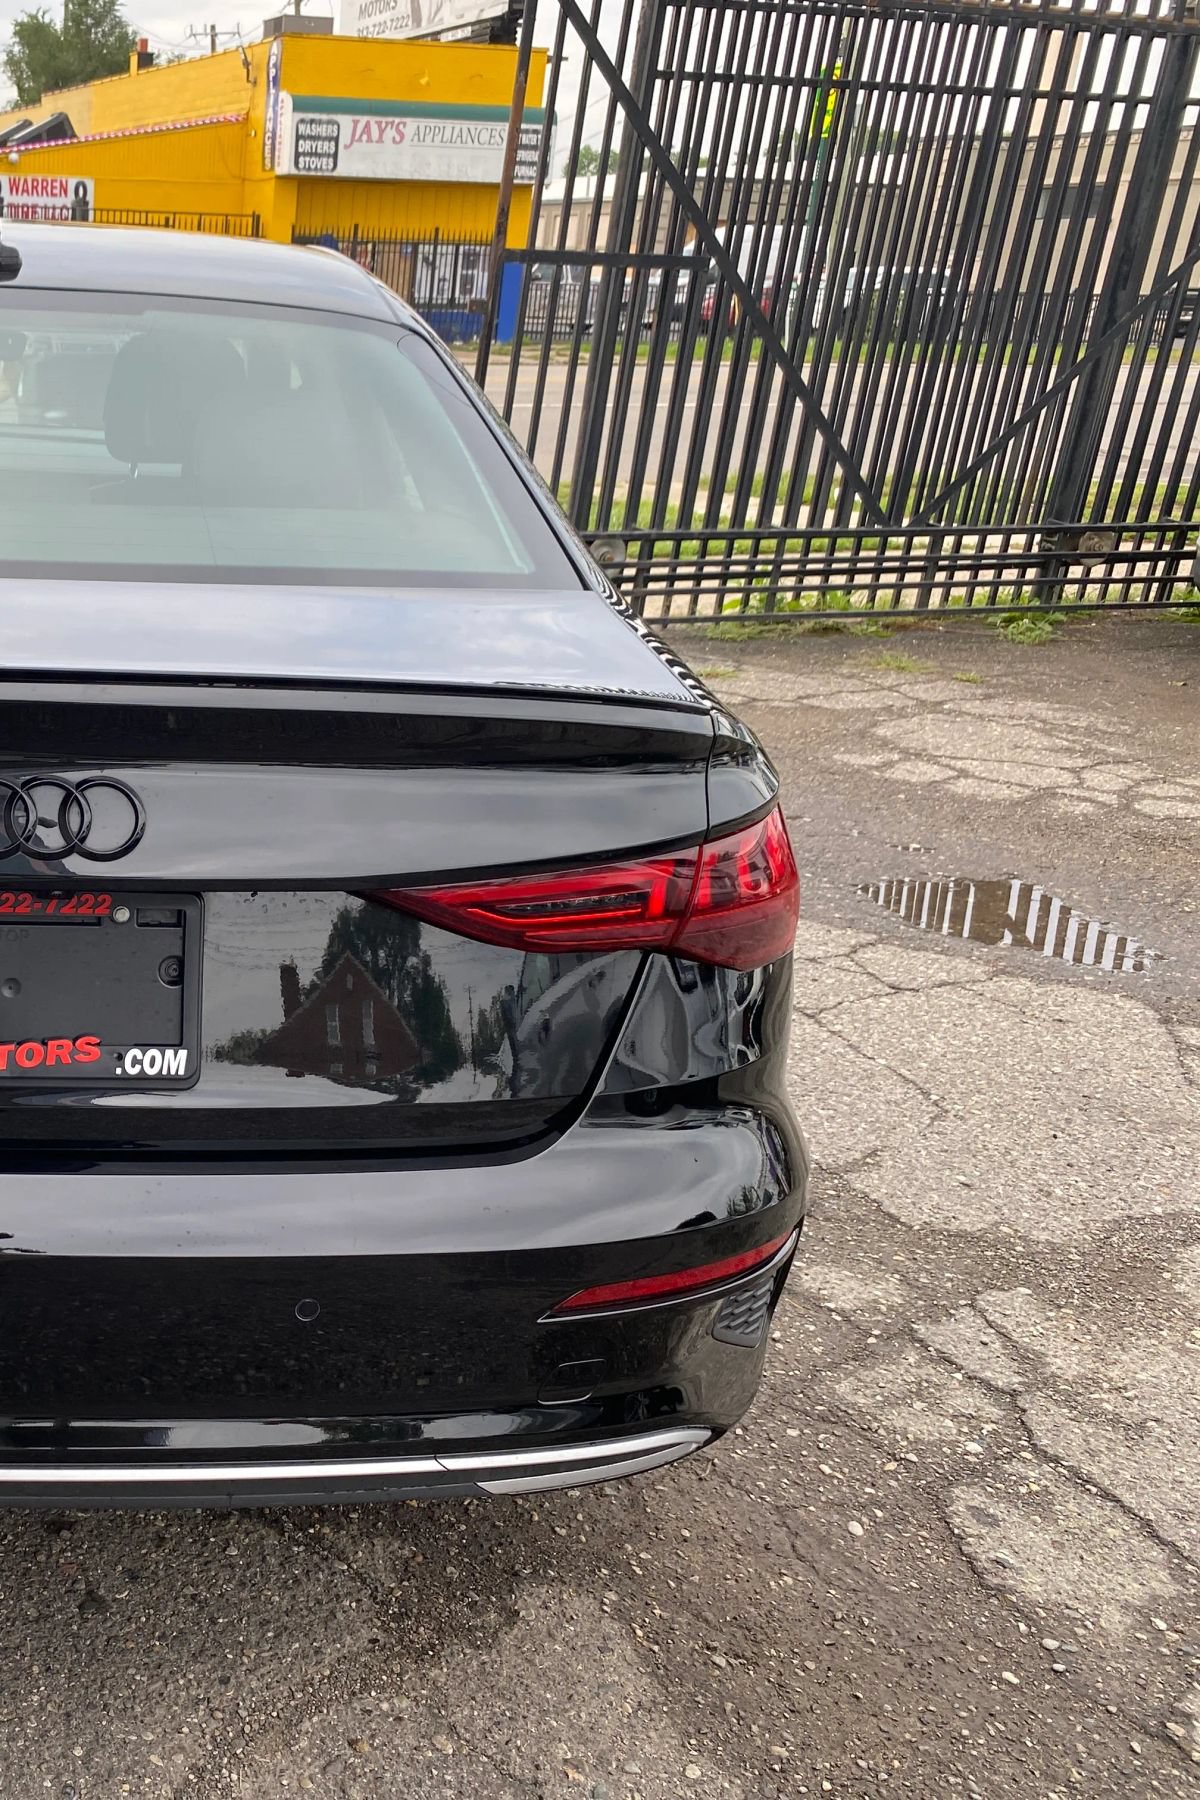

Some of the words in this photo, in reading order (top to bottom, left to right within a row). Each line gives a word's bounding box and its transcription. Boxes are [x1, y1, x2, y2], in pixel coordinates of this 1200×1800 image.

[358, 0, 398, 22] MOTORS
[298, 123, 338, 137] WASHERS
[344, 119, 407, 150] JAY'S
[411, 124, 506, 147] APPLIANCES
[298, 140, 335, 154] DRYERS
[298, 156, 334, 170] STOVES
[513, 165, 537, 177] FURNAC
[8, 176, 68, 198] WARREN
[115, 1049, 188, 1076] .COM
